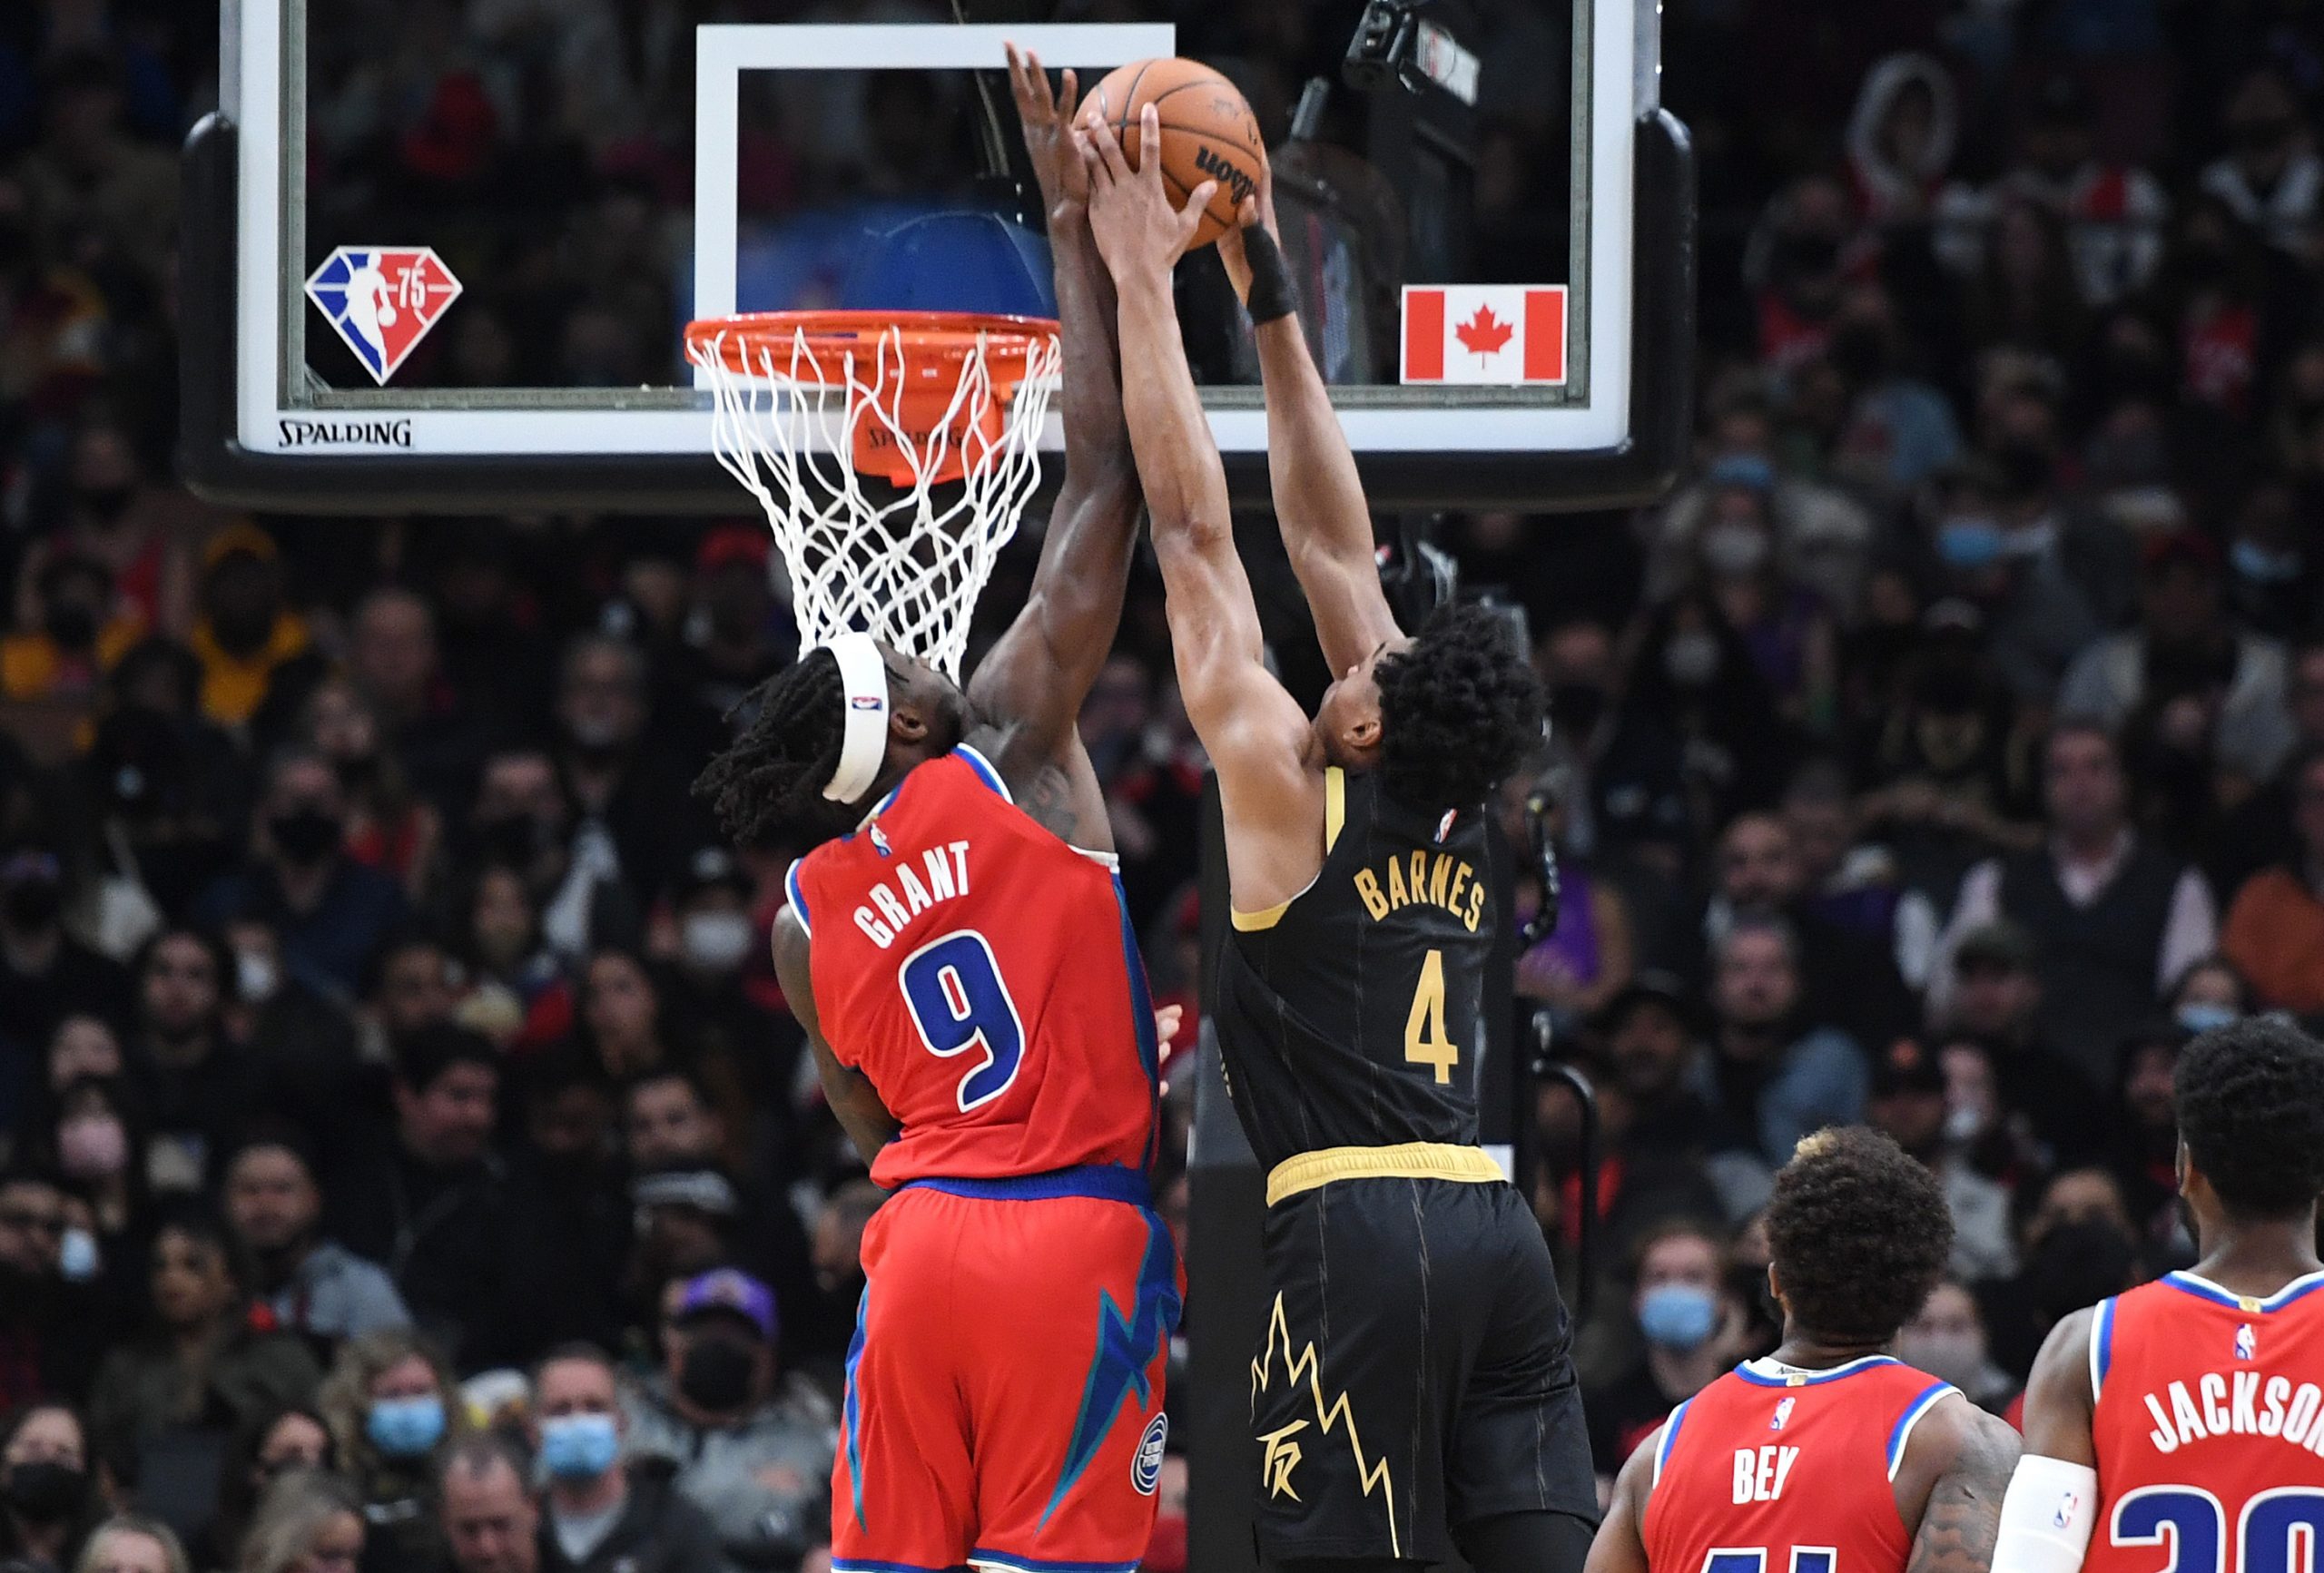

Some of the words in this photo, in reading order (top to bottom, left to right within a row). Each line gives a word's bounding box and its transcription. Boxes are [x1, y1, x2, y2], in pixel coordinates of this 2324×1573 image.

[396, 266, 426, 310] 75
[278, 418, 412, 447] SPALDING
[869, 426, 964, 448] SPDG
[853, 840, 970, 949] GRANT
[1353, 849, 1485, 933] BARNES
[898, 929, 1026, 1114] 9
[1404, 949, 1459, 1085] 4
[1732, 1445, 1800, 1505] BEY
